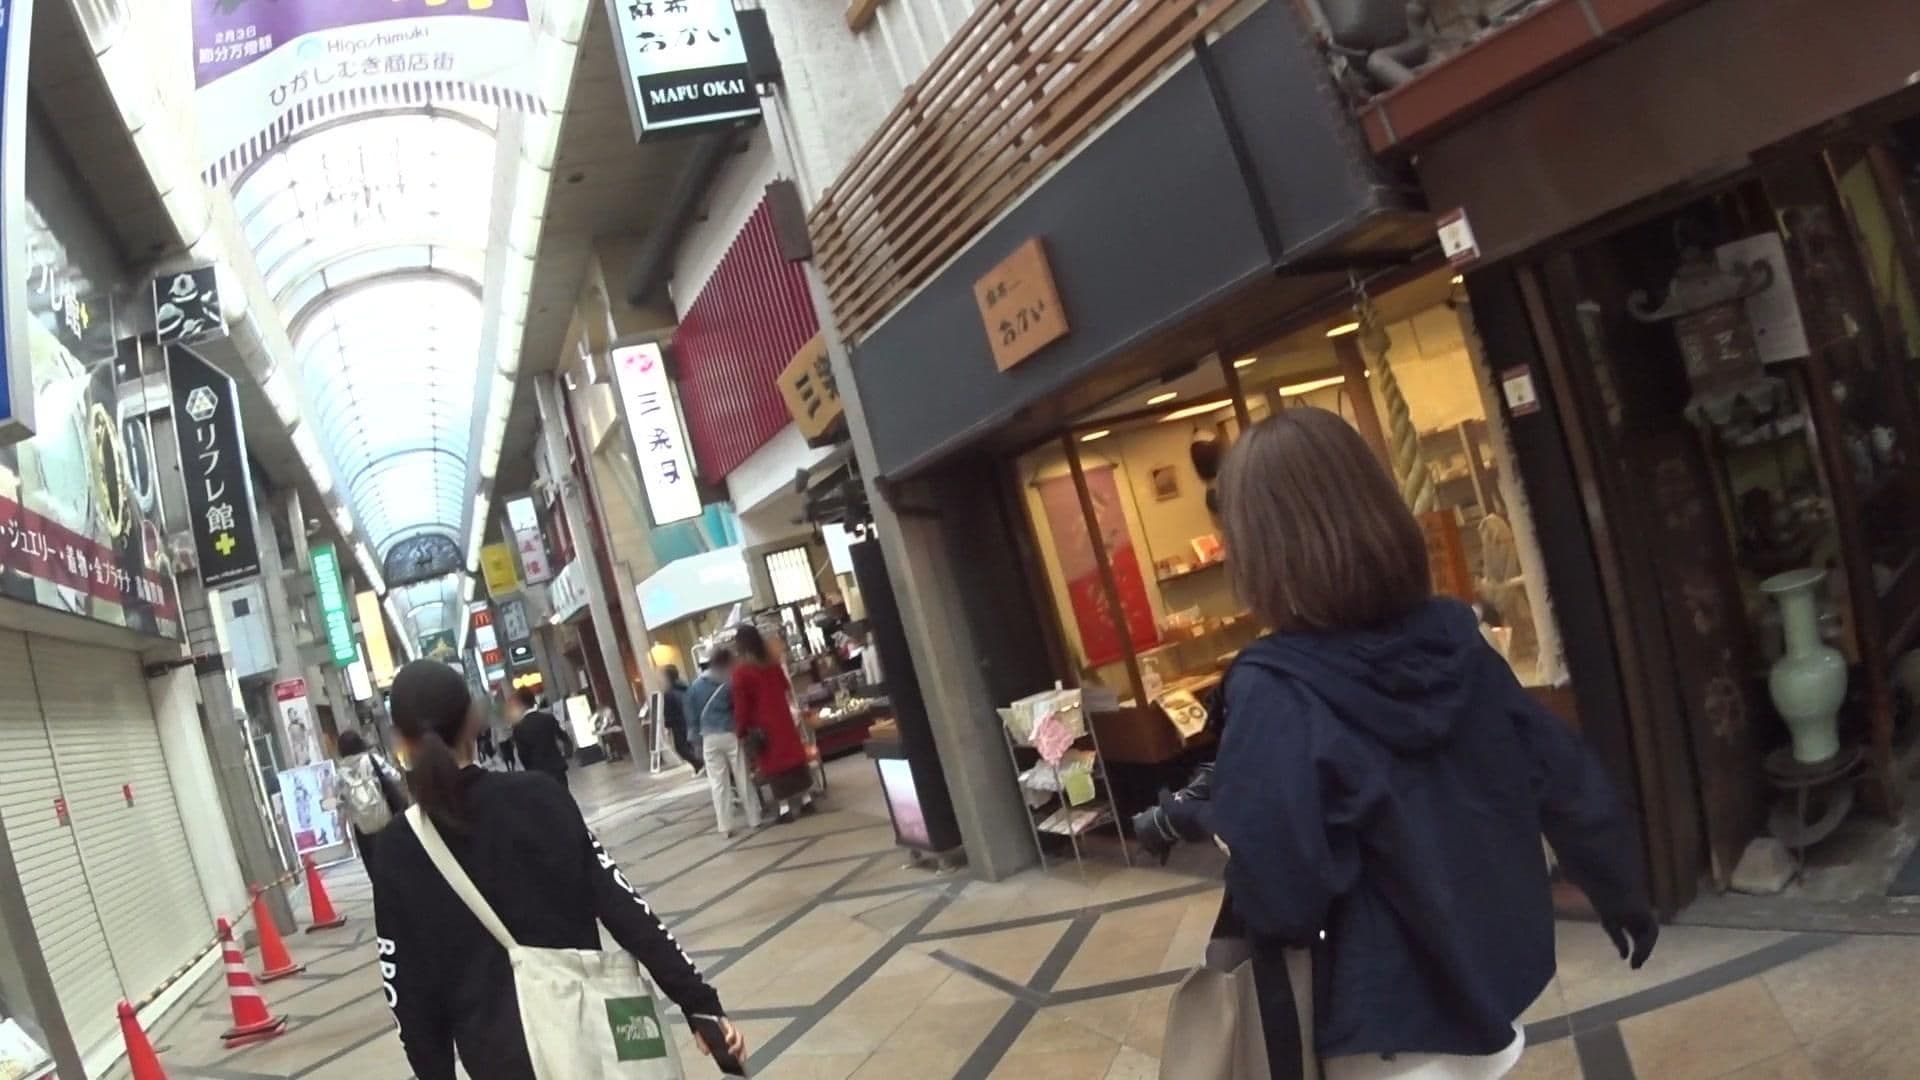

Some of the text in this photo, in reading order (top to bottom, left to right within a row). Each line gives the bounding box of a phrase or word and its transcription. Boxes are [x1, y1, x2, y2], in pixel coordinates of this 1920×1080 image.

[327, 26, 430, 54] Higashimuki
[635, 27, 732, 53] おかい
[268, 51, 455, 107] ひがしむき商店街
[650, 78, 746, 106] MAFU OKAI
[196, 423, 236, 534] リフレ館
